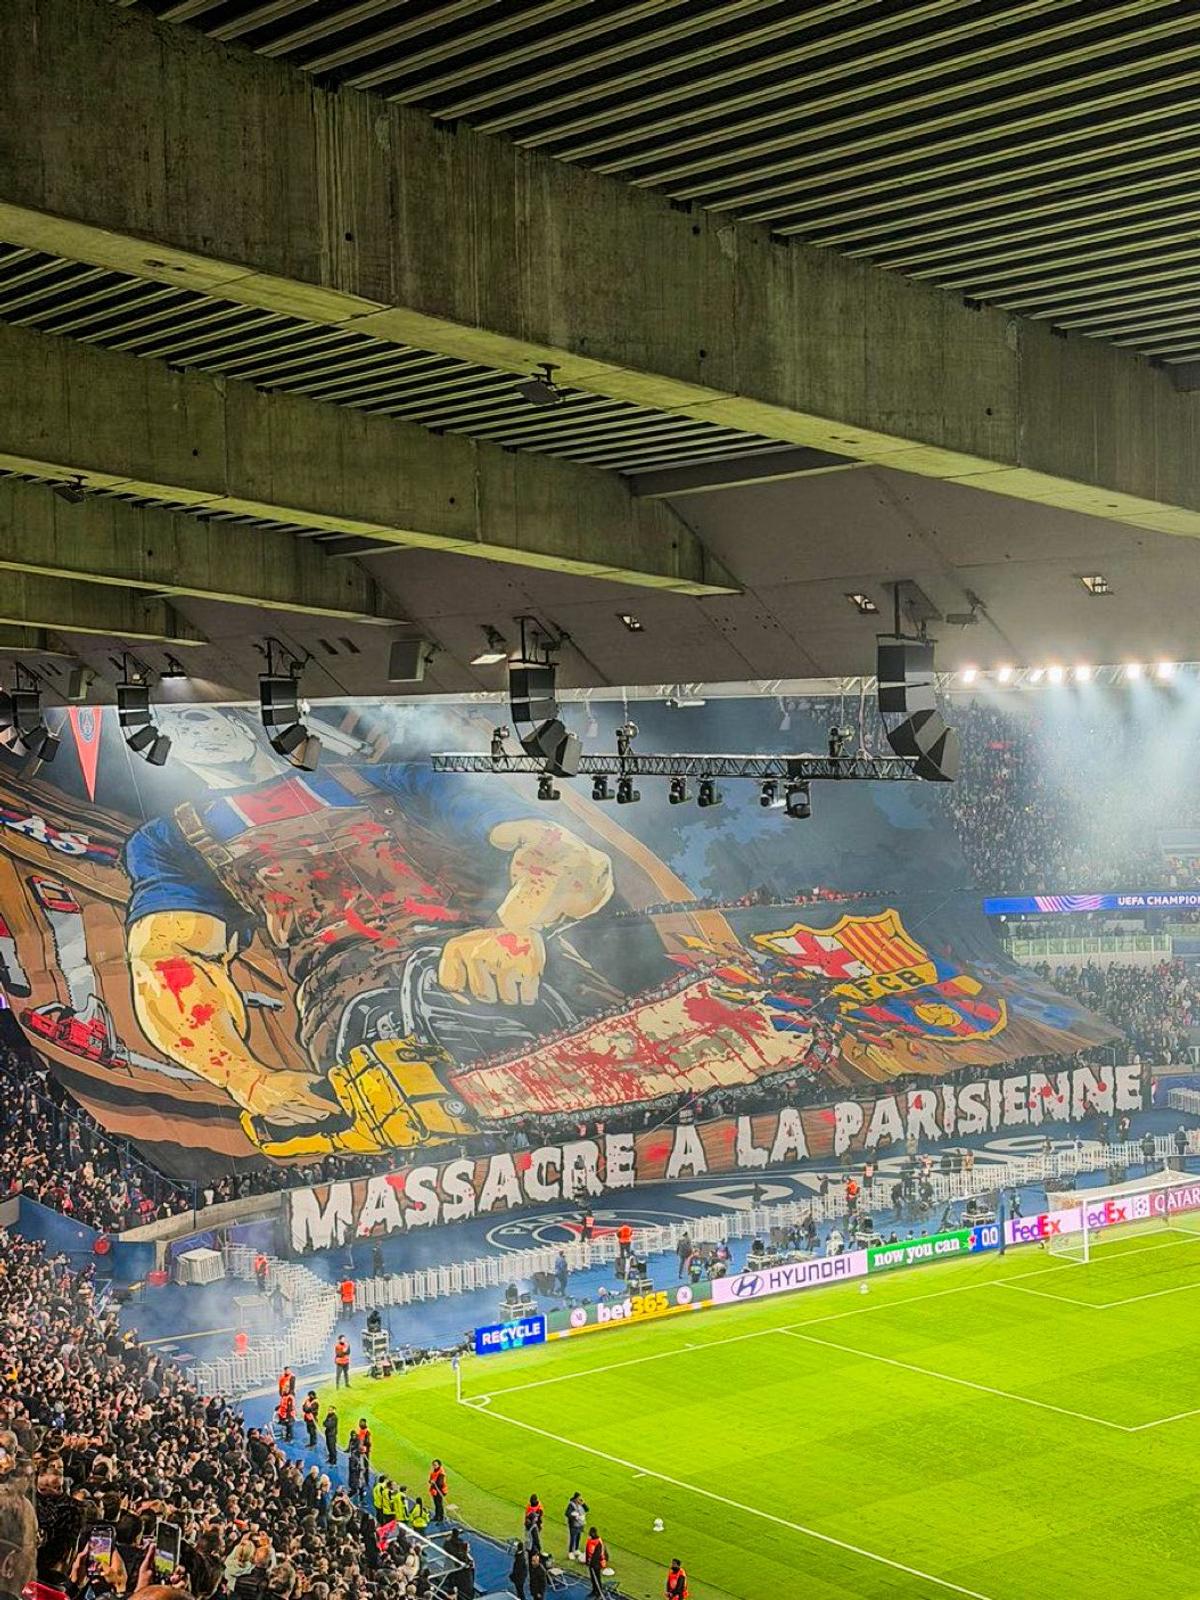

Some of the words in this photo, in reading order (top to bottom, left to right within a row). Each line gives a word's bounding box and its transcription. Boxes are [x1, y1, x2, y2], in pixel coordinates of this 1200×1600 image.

[1117, 895, 1145, 906] UEFA
[1147, 895, 1200, 905] CHAMPIO
[853, 970, 926, 998] FCB
[290, 1134, 636, 1254] MASSACRE
[666, 1125, 708, 1179] A
[736, 1106, 809, 1169] LA
[834, 1065, 1143, 1157] PARISIENNE
[1012, 1214, 1061, 1242] FedEx
[875, 1250, 904, 1265] now
[906, 1243, 933, 1264] you
[936, 1237, 959, 1251] can
[769, 1257, 851, 1289] HYUNDAI
[597, 1291, 669, 1323] bet365
[481, 1322, 542, 1346] RECYCLE
